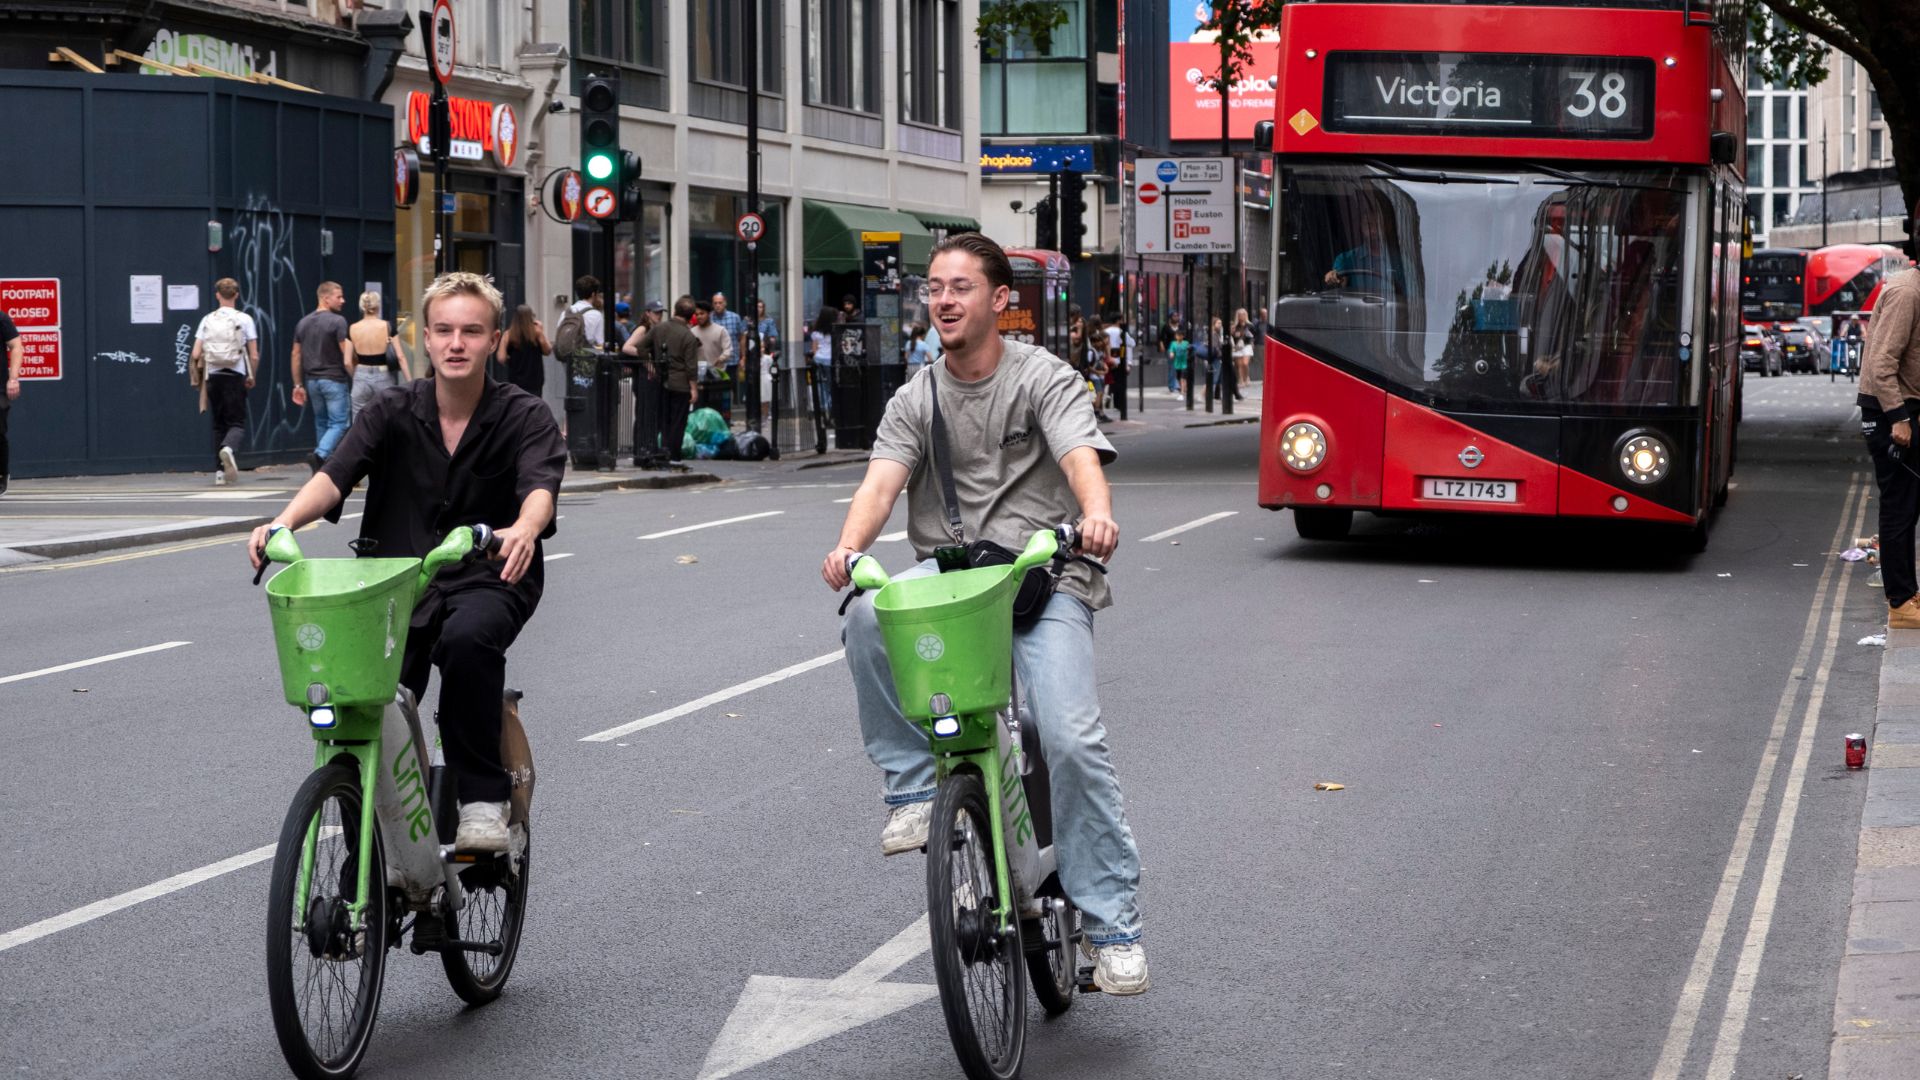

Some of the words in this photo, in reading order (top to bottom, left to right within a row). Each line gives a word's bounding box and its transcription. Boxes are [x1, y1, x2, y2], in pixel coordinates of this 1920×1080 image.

[1375, 75, 1501, 107] Victoria
[1566, 72, 1627, 118] 38
[1196, 99, 1221, 108] WEST
[1243, 99, 1275, 108] PREMIE
[448, 95, 494, 151] STONE
[1174, 198, 1208, 206] Holborn
[1194, 210, 1223, 218] Euston
[741, 221, 760, 233] 20
[1174, 242, 1208, 250] Camden
[1211, 242, 1233, 250] Town
[2, 289, 55, 300] FOOTPATH
[8, 307, 50, 319] CLOSED
[39, 345, 55, 353] USE
[23, 356, 44, 364] THER
